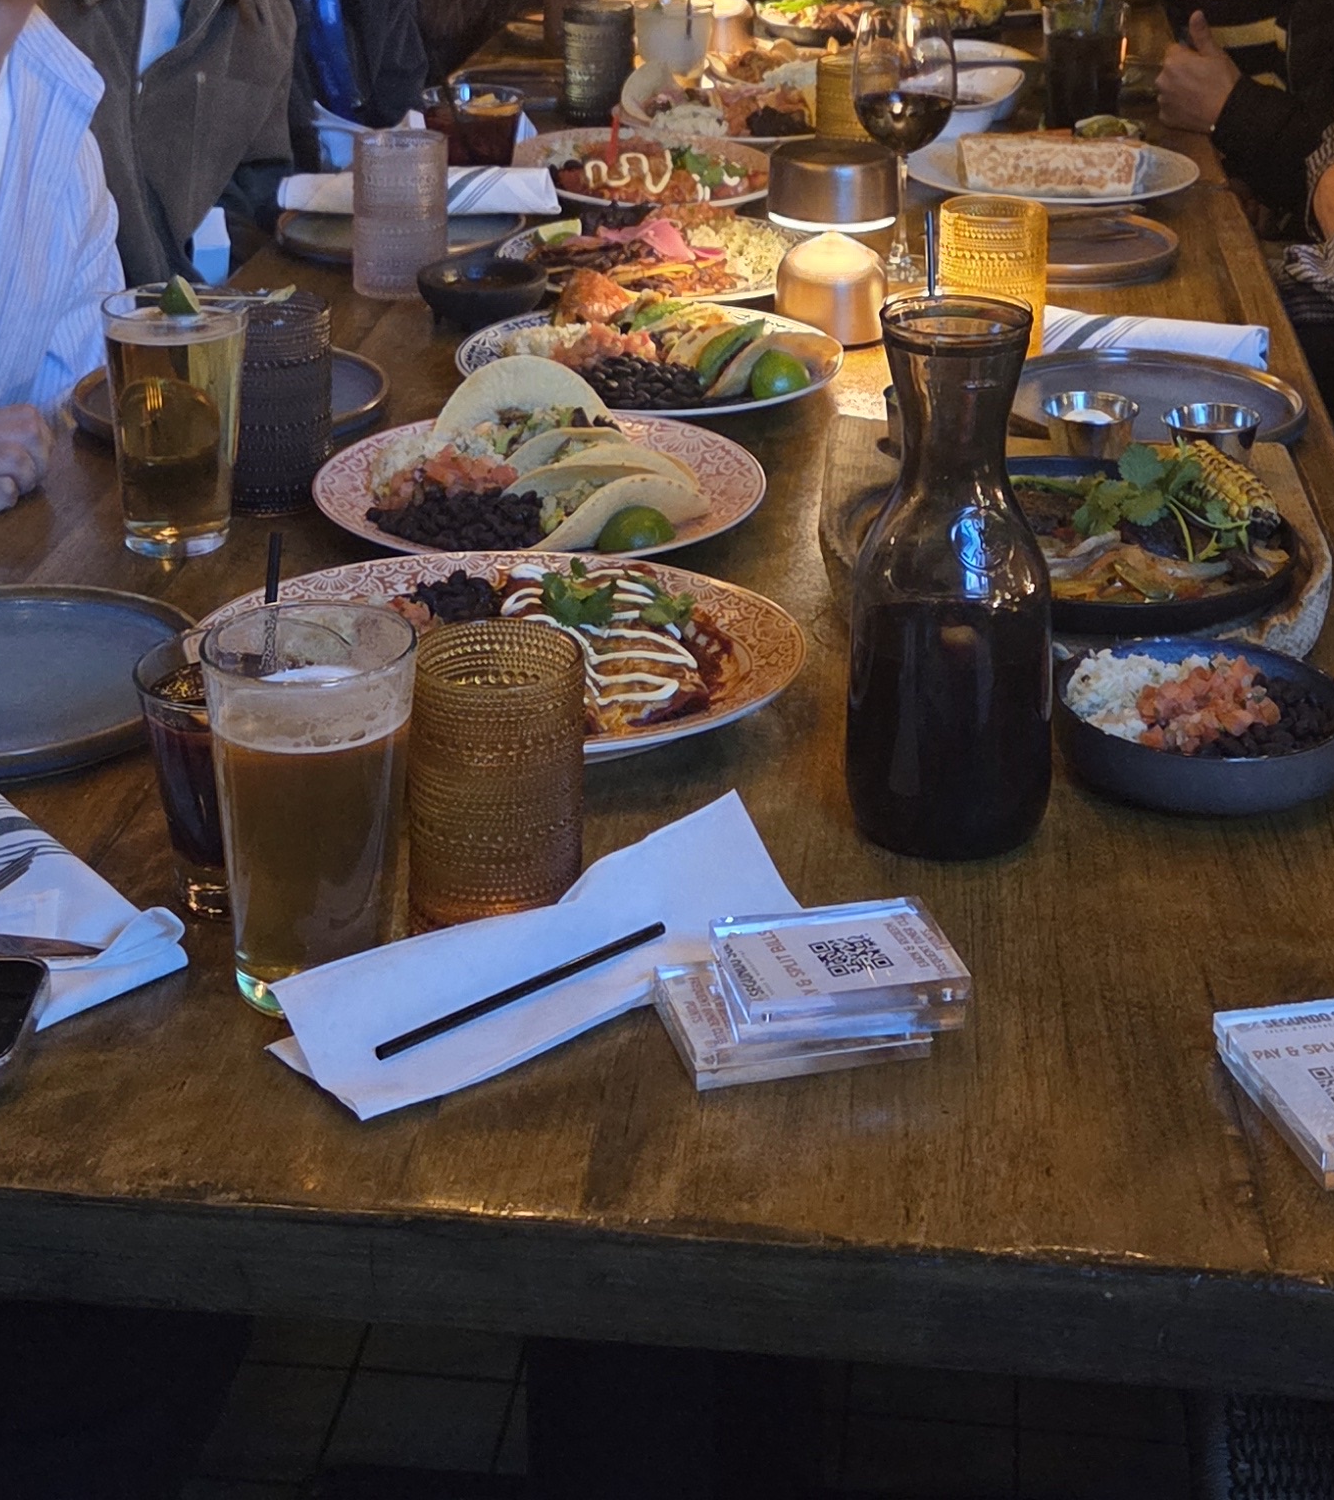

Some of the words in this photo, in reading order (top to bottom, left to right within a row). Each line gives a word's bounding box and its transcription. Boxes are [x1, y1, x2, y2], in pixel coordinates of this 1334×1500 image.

[775, 954, 806, 978] SPLIT
[1261, 1012, 1329, 1029] SEGUNDO
[1253, 1048, 1282, 1061] PAY
[1285, 1046, 1300, 1057] &
